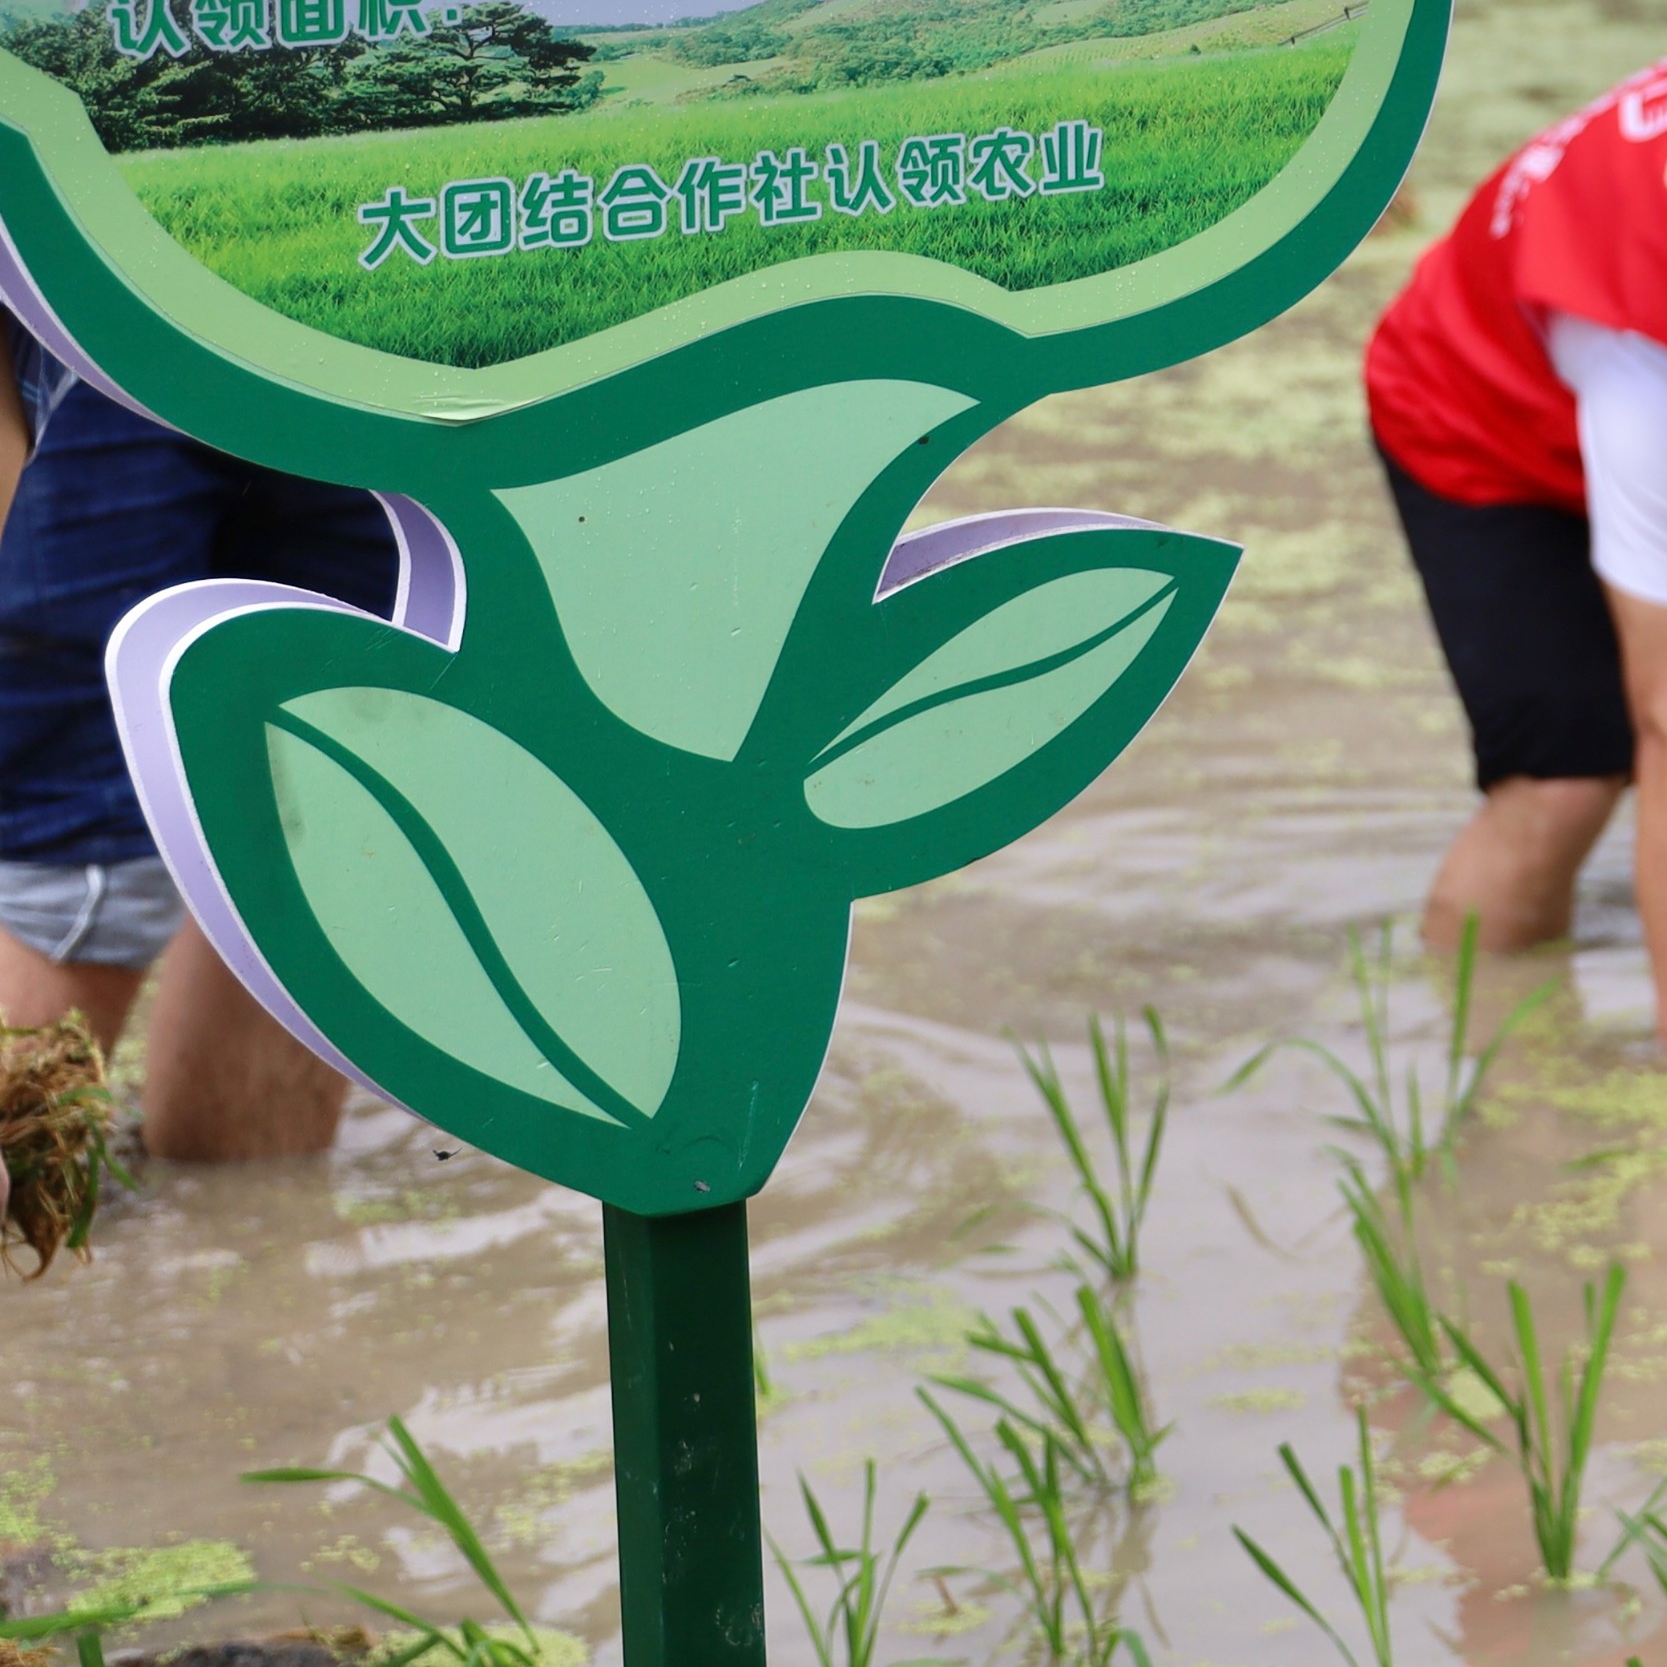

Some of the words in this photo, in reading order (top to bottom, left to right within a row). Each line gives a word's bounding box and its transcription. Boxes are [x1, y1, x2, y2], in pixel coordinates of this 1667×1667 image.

[358, 122, 1106, 272] 大团结合作社认领农业
